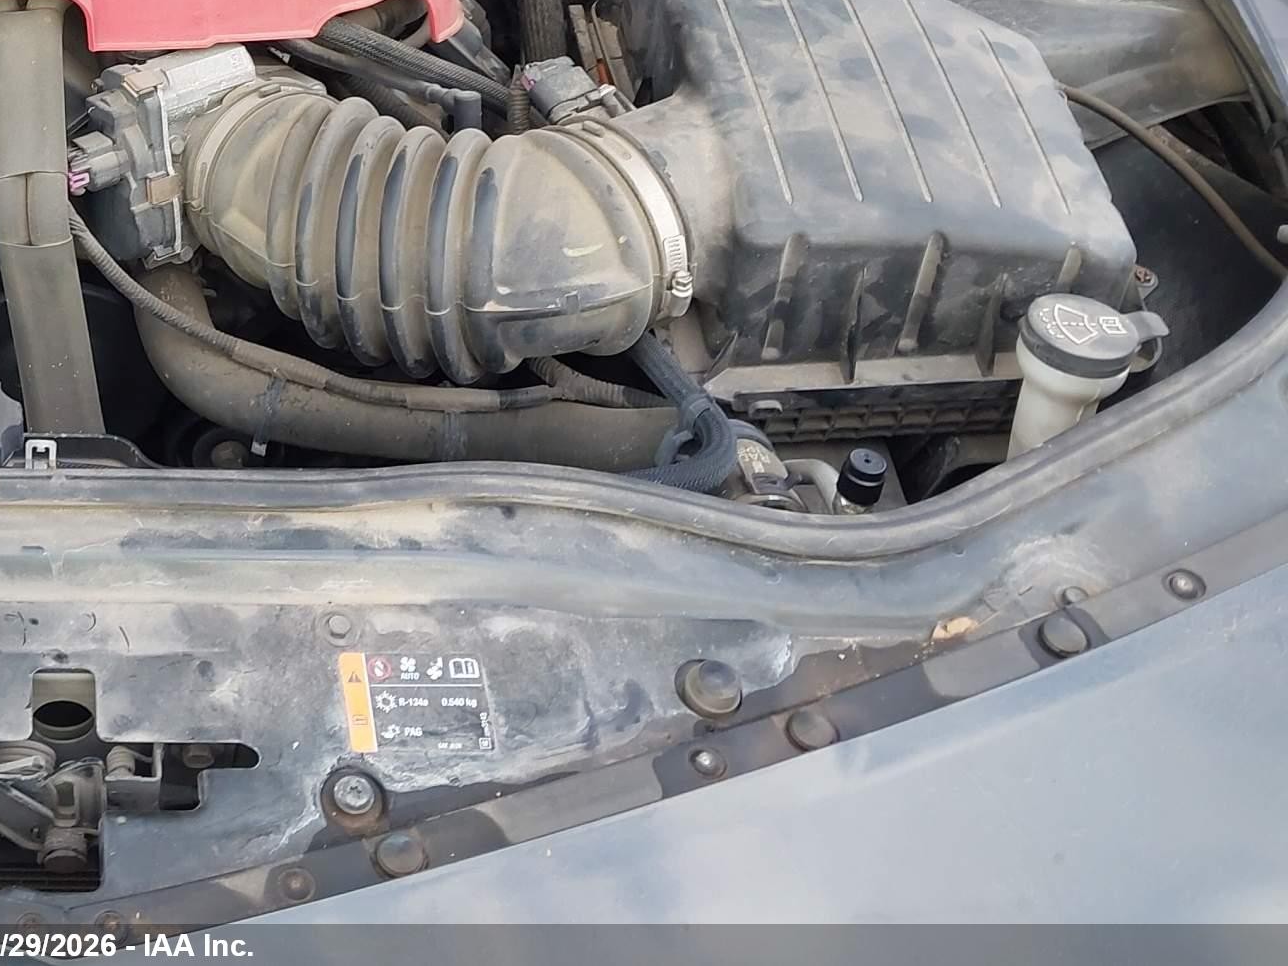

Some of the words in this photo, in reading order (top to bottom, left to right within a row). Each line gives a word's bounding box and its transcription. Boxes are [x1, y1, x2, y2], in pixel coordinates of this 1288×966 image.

[400, 672, 420, 681] AUTO
[465, 697, 478, 708] kg
[404, 726, 423, 737] PAG
